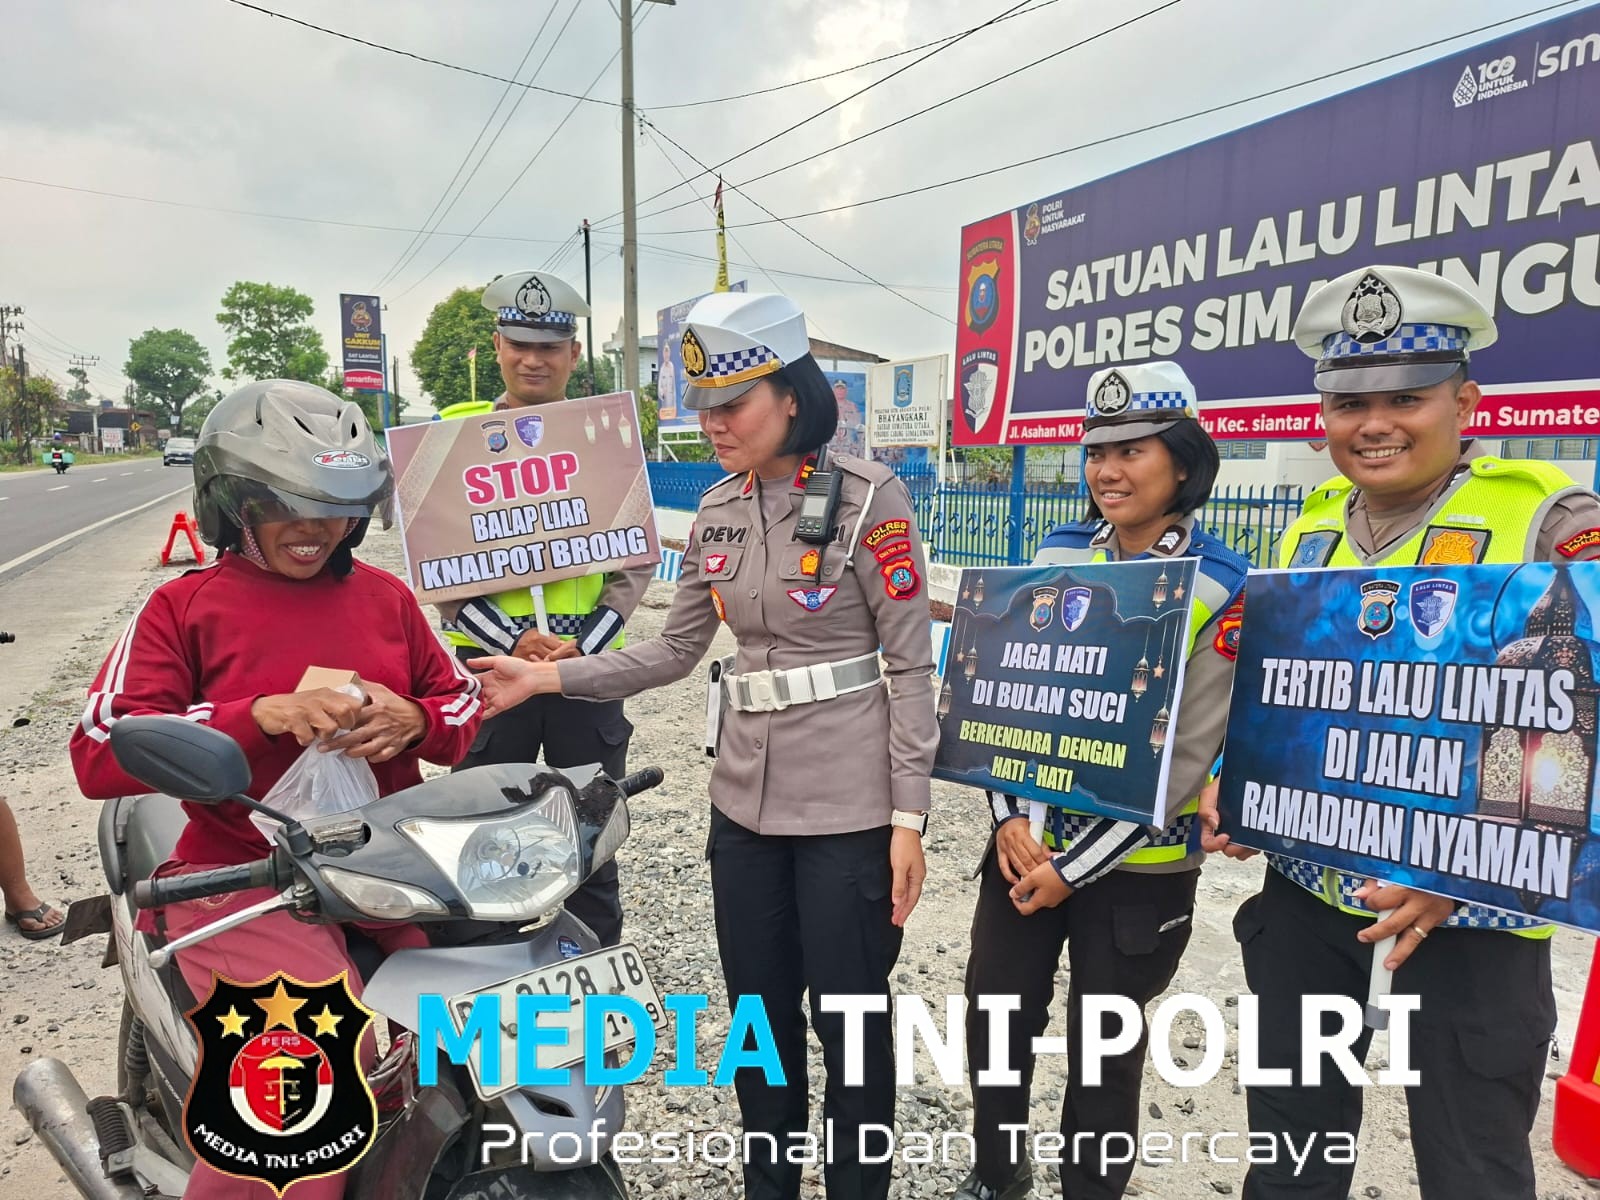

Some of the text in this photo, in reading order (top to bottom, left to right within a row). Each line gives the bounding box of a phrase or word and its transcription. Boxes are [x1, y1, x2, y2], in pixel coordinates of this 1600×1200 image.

[1477, 79, 1529, 101] INDONESIA
[1479, 74, 1514, 92] UNTUK
[1041, 209, 1064, 224] UNTUK
[1041, 213, 1086, 235] MASYARAKAT
[1042, 200, 1063, 214] POLRI
[1045, 233, 1208, 311] SATUAN
[1216, 195, 1363, 278] LALU
[1023, 305, 1184, 373] POLRES
[962, 351, 996, 366] LALU LINTAS
[878, 412, 927, 423] BHAYANGKARI
[1009, 426, 1019, 439] Jl.
[1021, 423, 1056, 439] Asahan
[1058, 424, 1074, 437] KM
[1217, 417, 1248, 433] Kec.
[1252, 413, 1311, 432] siantar
[1497, 404, 1600, 427] Sumate
[463, 452, 579, 505] STOP
[472, 498, 589, 543] BALAP LIAR
[701, 526, 747, 543] DEVI
[866, 521, 907, 546] POLRES
[420, 526, 649, 591] KNALPOT BRONG
[1000, 642, 1108, 676] JAGA HATI
[972, 679, 1128, 724] DI BULAN SUCI
[1261, 658, 1575, 731] TERTIB LALU LINTAS
[959, 719, 1127, 769] BERKENDARA DENGAN
[1324, 727, 1464, 797] DI JALAN
[991, 756, 1027, 782] HATI
[1035, 767, 1074, 793] HATI
[1241, 781, 1573, 899] RAMADHAN NYAMAN
